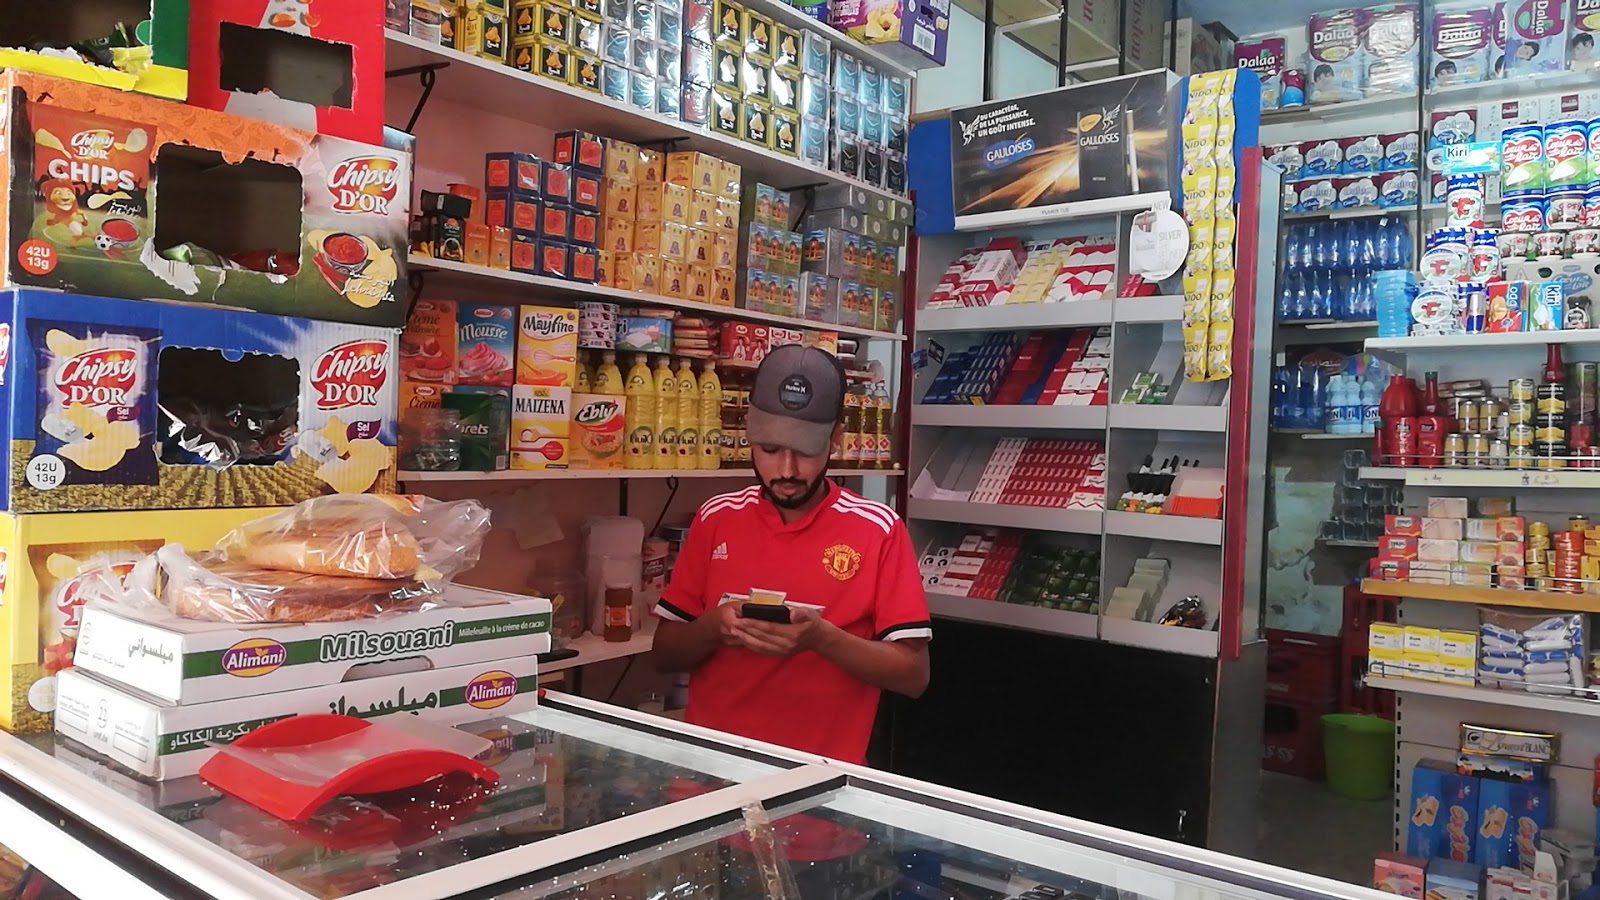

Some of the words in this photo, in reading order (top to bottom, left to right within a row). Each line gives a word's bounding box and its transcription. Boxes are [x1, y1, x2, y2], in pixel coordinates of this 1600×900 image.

[1535, 1, 1550, 35] Dalaa
[1313, 29, 1355, 44] Dalaa
[1238, 56, 1276, 68] Dalaa
[1189, 88, 1212, 99] NIDO
[996, 109, 1029, 124] PUISSANCE,
[988, 124, 1006, 135] GOÛT
[1006, 118, 1036, 130] INTENSE.
[71, 131, 115, 149] Chipsy
[1080, 132, 1120, 146] GAULOISES
[1184, 139, 1207, 149] NIDO
[79, 145, 109, 160] D'OR
[986, 139, 1033, 162] GAULOISES
[1447, 143, 1468, 157] Kiri
[48, 158, 135, 191] CHIPS
[327, 161, 400, 192] Chipsy
[339, 189, 388, 214] D'OR
[1183, 189, 1206, 200] NIDO
[1153, 200, 1169, 210] NEW
[1158, 229, 1182, 241] SILVER
[25, 245, 50, 258] 42U
[27, 256, 50, 270] 13g
[1546, 285, 1560, 306] Kiri
[460, 323, 508, 342] Mousse
[523, 315, 574, 334] Mayfine
[55, 352, 137, 386] Chipsy
[309, 344, 390, 383] Chipsy
[69, 384, 127, 405] D'OR
[324, 383, 377, 405] D'OR
[116, 407, 130, 417] Sel
[515, 398, 565, 414] MAIZENA
[578, 403, 617, 423] Ebly
[355, 421, 371, 432] Sel
[34, 463, 57, 473] 42U
[35, 473, 57, 484] 13g
[459, 626, 491, 637] Millefeuille
[496, 624, 502, 632] la
[502, 623, 520, 632] crème
[520, 621, 529, 630] de
[528, 620, 545, 629] cacao
[320, 622, 454, 662] Milsouani
[227, 650, 283, 670] Alimani
[469, 681, 515, 702] Alimani
[171, 728, 213, 750] الكاكاو
